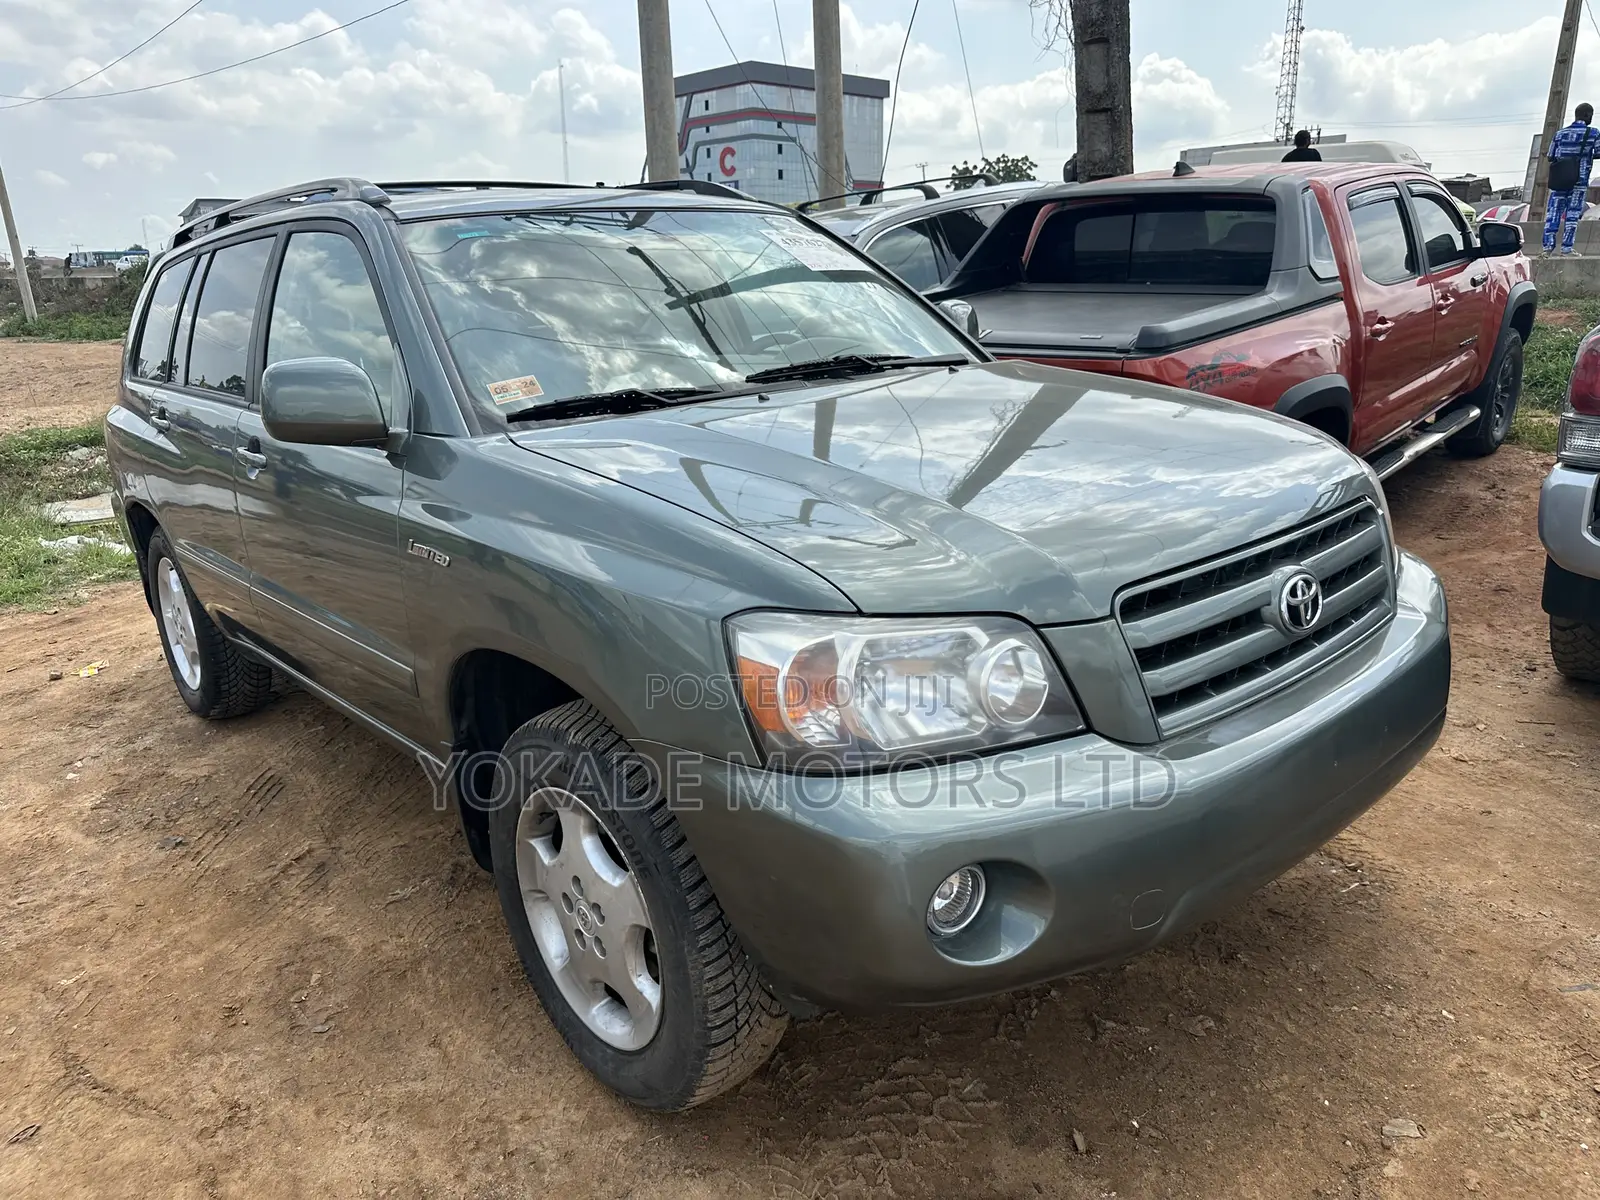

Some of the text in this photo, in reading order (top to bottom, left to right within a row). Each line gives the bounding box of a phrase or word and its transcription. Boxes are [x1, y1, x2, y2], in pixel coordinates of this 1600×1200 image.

[719, 146, 737, 177] C
[494, 385, 509, 395] 05
[520, 380, 536, 389] 24
